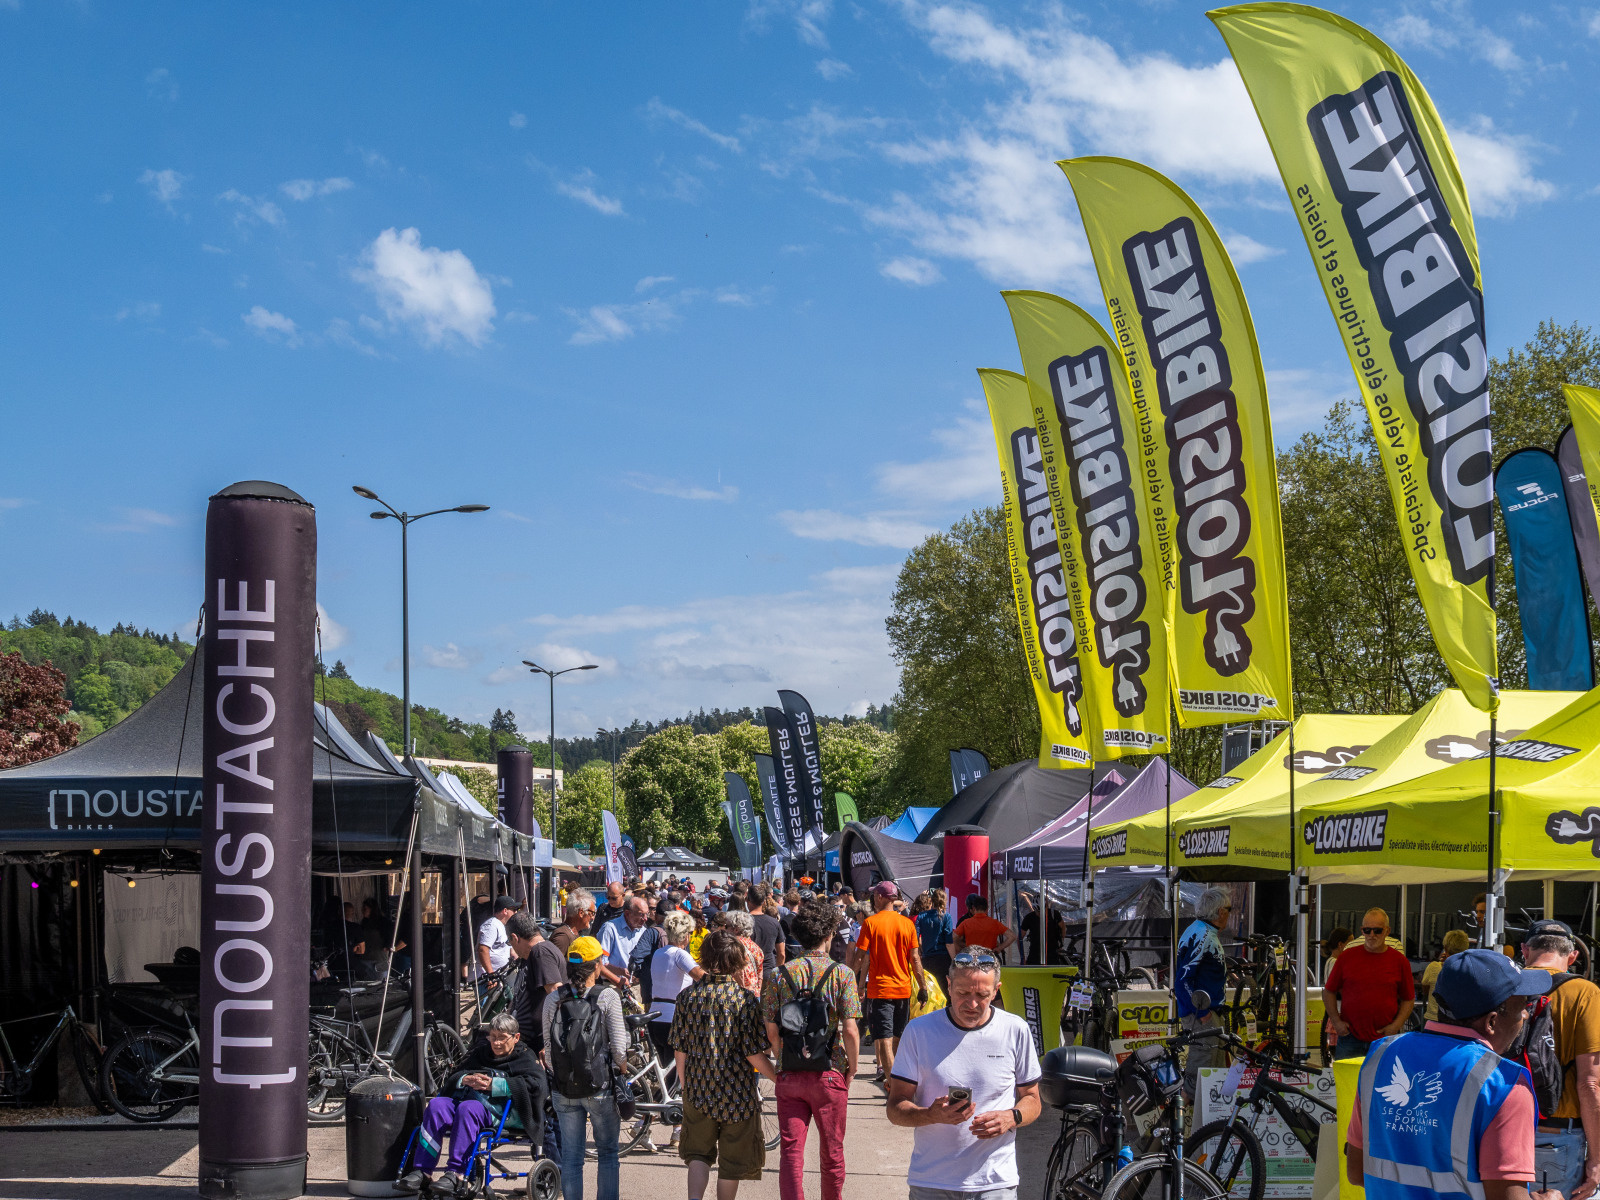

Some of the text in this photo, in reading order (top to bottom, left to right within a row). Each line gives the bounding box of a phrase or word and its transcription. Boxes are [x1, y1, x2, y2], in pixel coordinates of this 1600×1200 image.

[213, 578, 297, 1089] MOUSTACHE
[1389, 839, 1487, 854] Spécialiste vélos électriques et loisirs
[1014, 856, 1034, 873] FOCUS
[1381, 1106, 1429, 1119] SECOURS
[1385, 1121, 1427, 1135] FRANÇAIS
[1394, 1115, 1439, 1128] POPULAIRE
